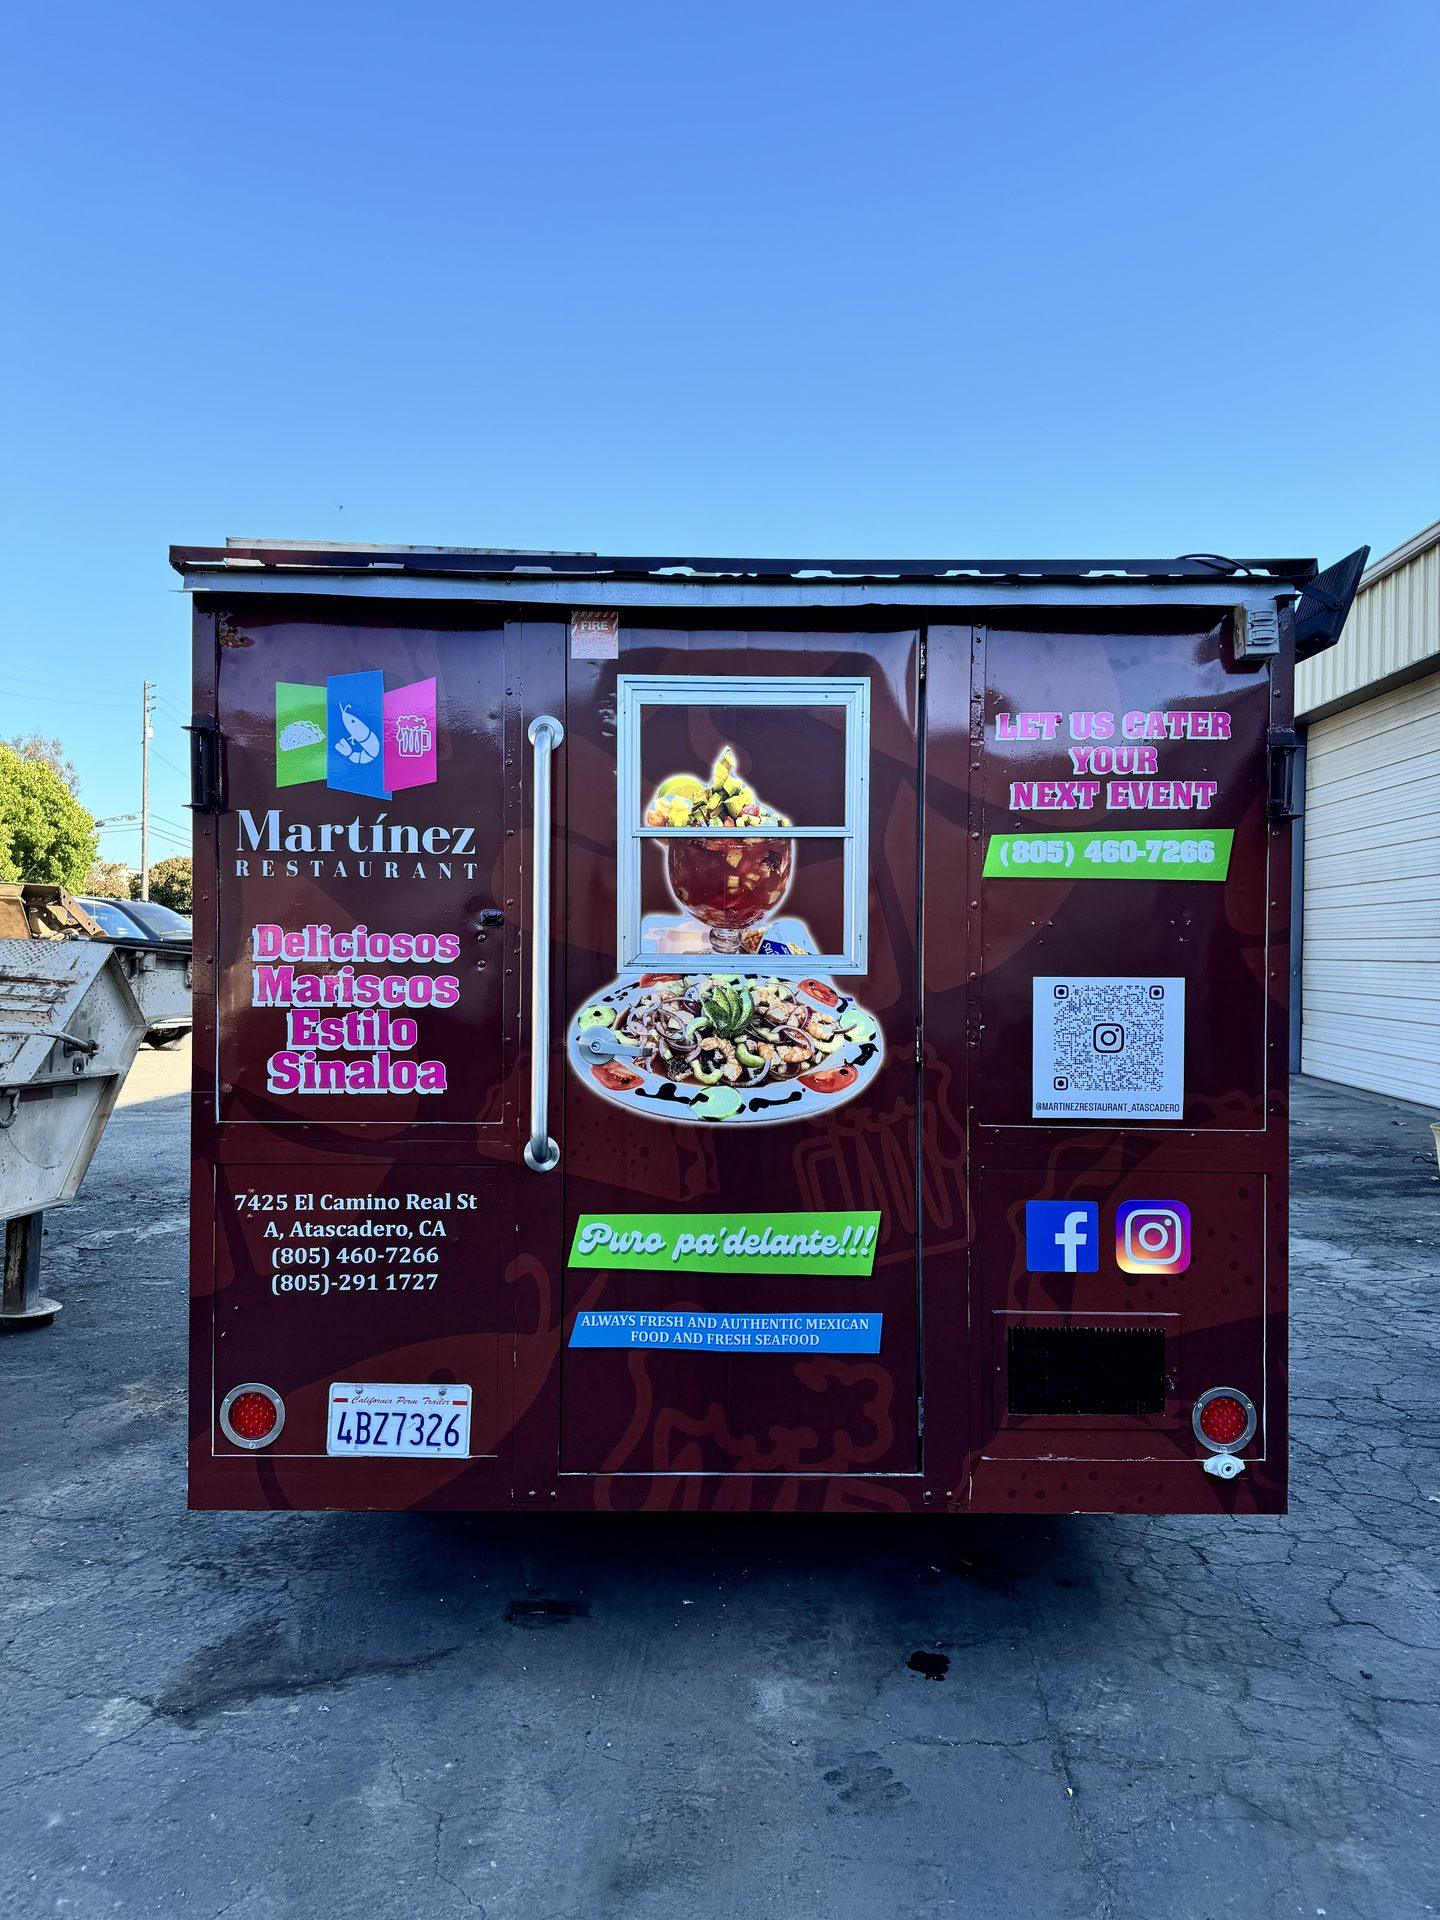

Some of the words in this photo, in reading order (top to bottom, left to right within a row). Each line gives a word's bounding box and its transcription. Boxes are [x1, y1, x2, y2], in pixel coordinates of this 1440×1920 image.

[580, 620, 609, 630] FIRE
[995, 712, 1062, 741] LET
[1069, 711, 1115, 740] US
[1122, 711, 1232, 740] CATER
[1068, 746, 1158, 775] YOUR
[1009, 781, 1100, 810] NEXT
[1106, 781, 1217, 810] EVENT
[235, 809, 476, 855] Martínez
[1000, 840, 1075, 867] (805)
[1083, 839, 1215, 864] 460-7266
[235, 859, 477, 880] RESTAURANT
[252, 924, 461, 963] Deliciosos
[252, 965, 460, 1008] Mariscos
[286, 1008, 418, 1051] Estilo
[266, 1051, 447, 1095] Sinaloa
[1035, 1101, 1180, 1112] @MARTINEZRESTAURANT_ATASCADERO
[234, 1194, 288, 1211] 7425
[294, 1193, 314, 1211] El
[320, 1193, 400, 1211] Camino
[406, 1193, 451, 1210] Real
[457, 1193, 478, 1210] St
[263, 1221, 284, 1240] A,
[289, 1220, 413, 1239] Atascadero,
[418, 1220, 447, 1237] CA
[578, 1222, 668, 1256] Puro
[671, 1225, 876, 1263] pa'delante!!!
[271, 1247, 330, 1269] (805)
[336, 1247, 439, 1264] 460-7266
[271, 1273, 378, 1296] (805)-291
[386, 1273, 439, 1290] 1727
[580, 1314, 636, 1327] ALWAYS
[639, 1315, 684, 1328] FRESH
[687, 1316, 717, 1329] AND
[720, 1317, 802, 1330] AUTHENTIC
[806, 1318, 870, 1331] MEXICAN
[630, 1330, 670, 1343] FOOD
[673, 1331, 703, 1344] AND
[706, 1332, 751, 1345] FRESH
[754, 1333, 820, 1346] SEAFOOD
[351, 1395, 392, 1405] California
[396, 1396, 418, 1405] Perm
[423, 1396, 450, 1406] Trailer
[336, 1411, 461, 1447] 4BZ7326
